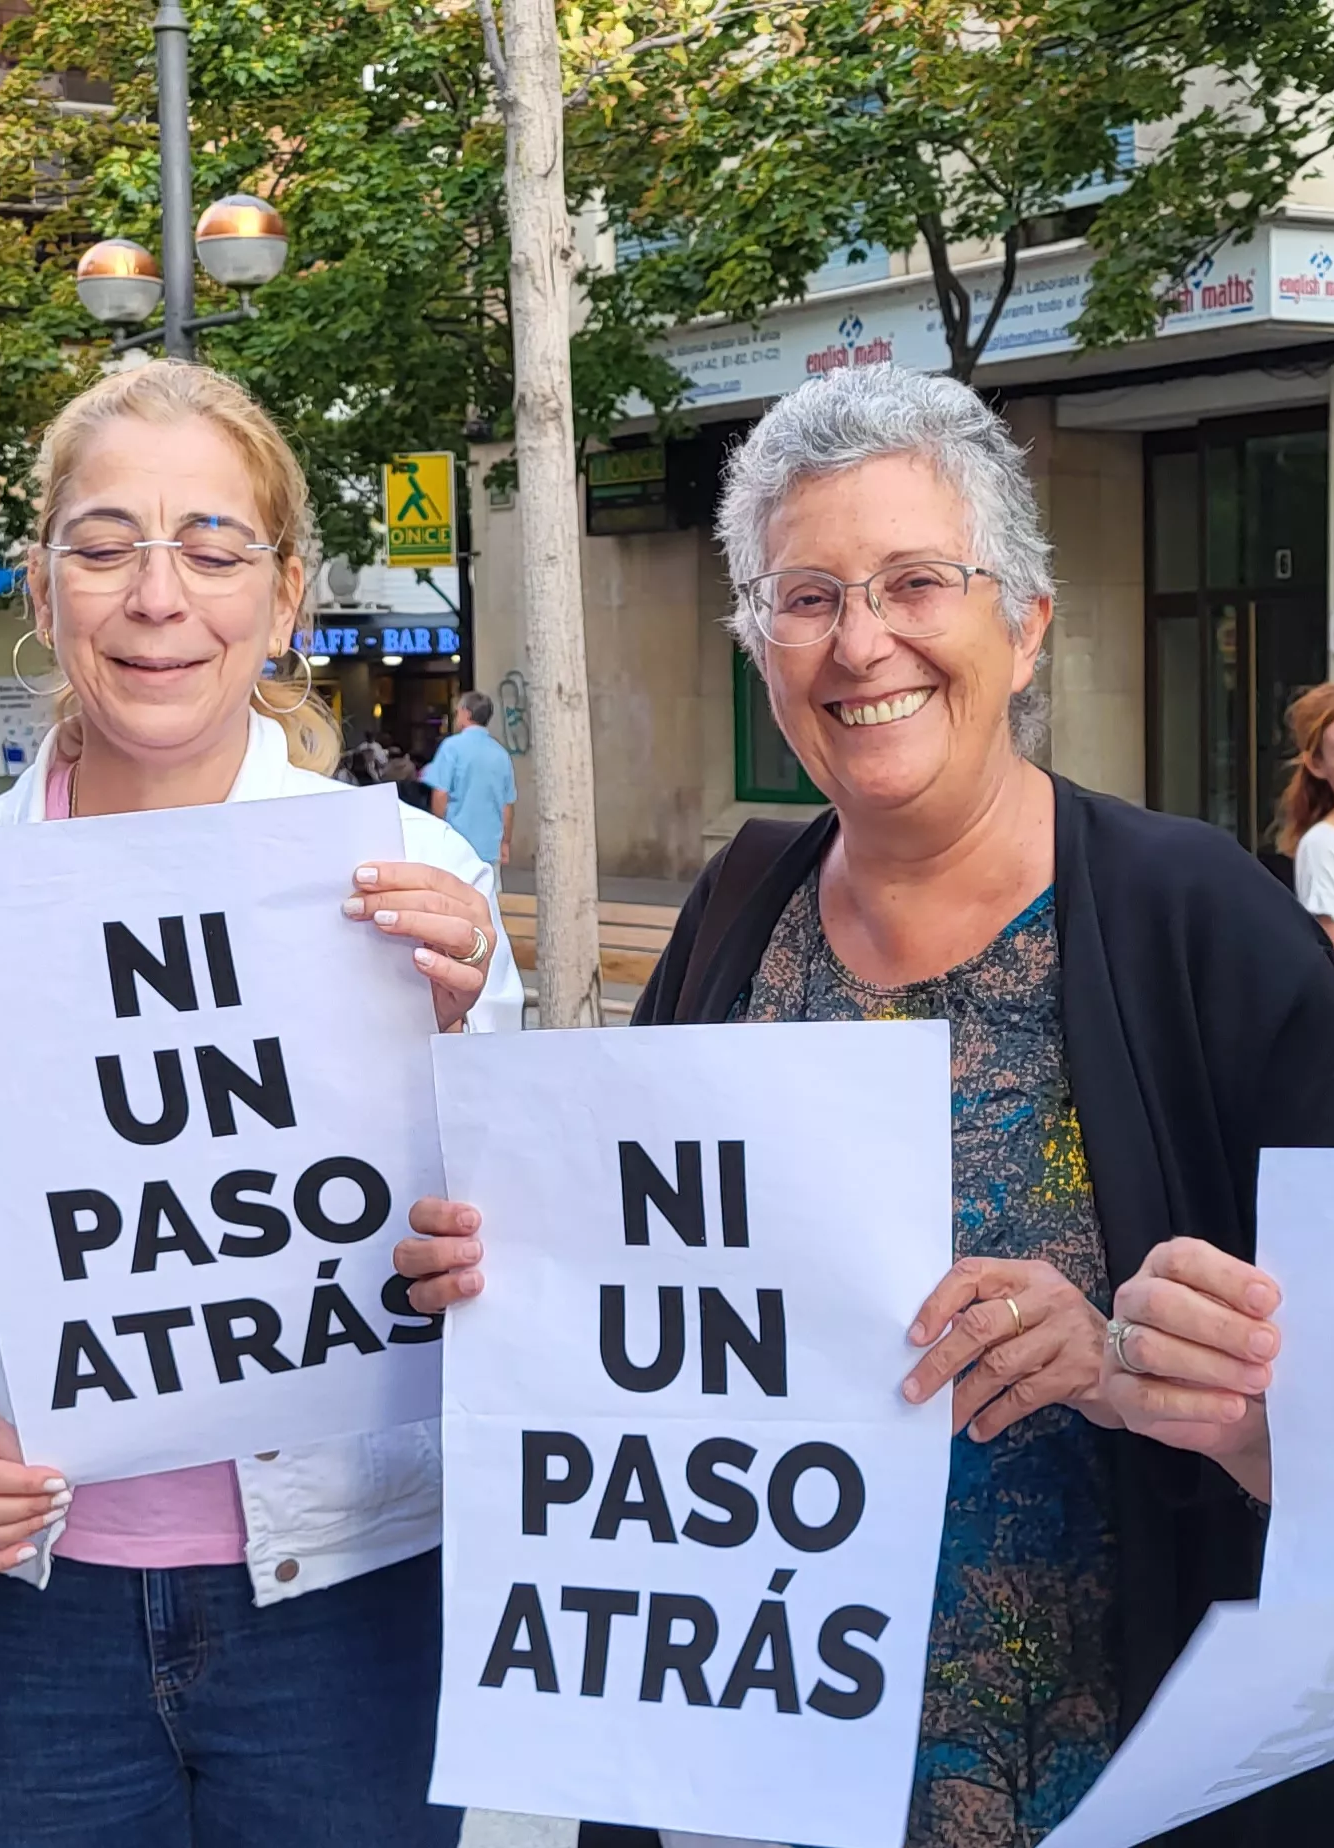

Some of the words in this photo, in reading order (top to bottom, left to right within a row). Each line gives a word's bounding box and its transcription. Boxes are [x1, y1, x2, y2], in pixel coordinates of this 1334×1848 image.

[1202, 272, 1255, 310] maths
[390, 527, 451, 545] ONCE
[381, 627, 433, 655] BAR
[102, 911, 243, 1019] NI
[94, 1036, 297, 1146] UN
[45, 1156, 392, 1282] PASO
[617, 1140, 750, 1249] NI
[599, 1284, 788, 1397] UN
[521, 1430, 866, 1553] PASO
[478, 1568, 891, 1721] ATRÁS
